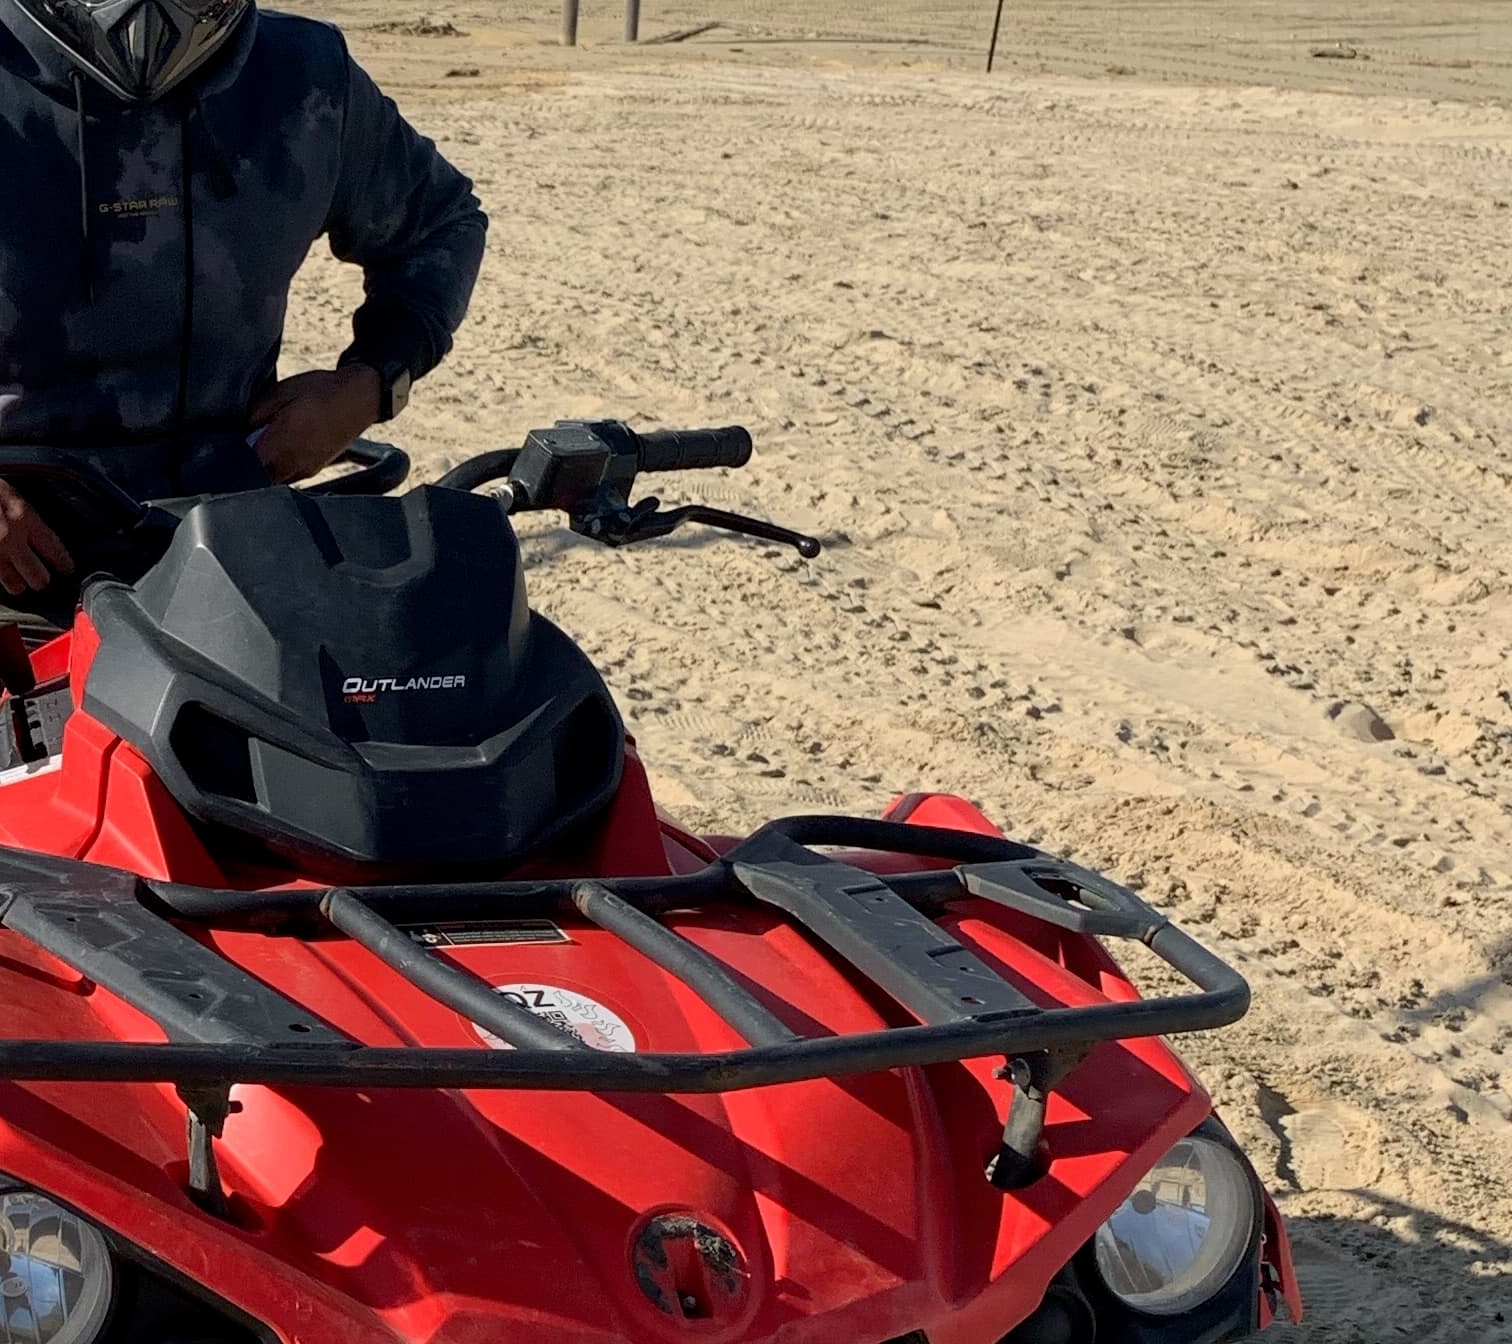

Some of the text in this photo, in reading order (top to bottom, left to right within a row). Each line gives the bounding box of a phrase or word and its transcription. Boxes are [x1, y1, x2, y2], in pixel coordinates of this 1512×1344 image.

[98, 197, 178, 213] G-STAR RAW
[342, 675, 466, 693] OUTLANDER
